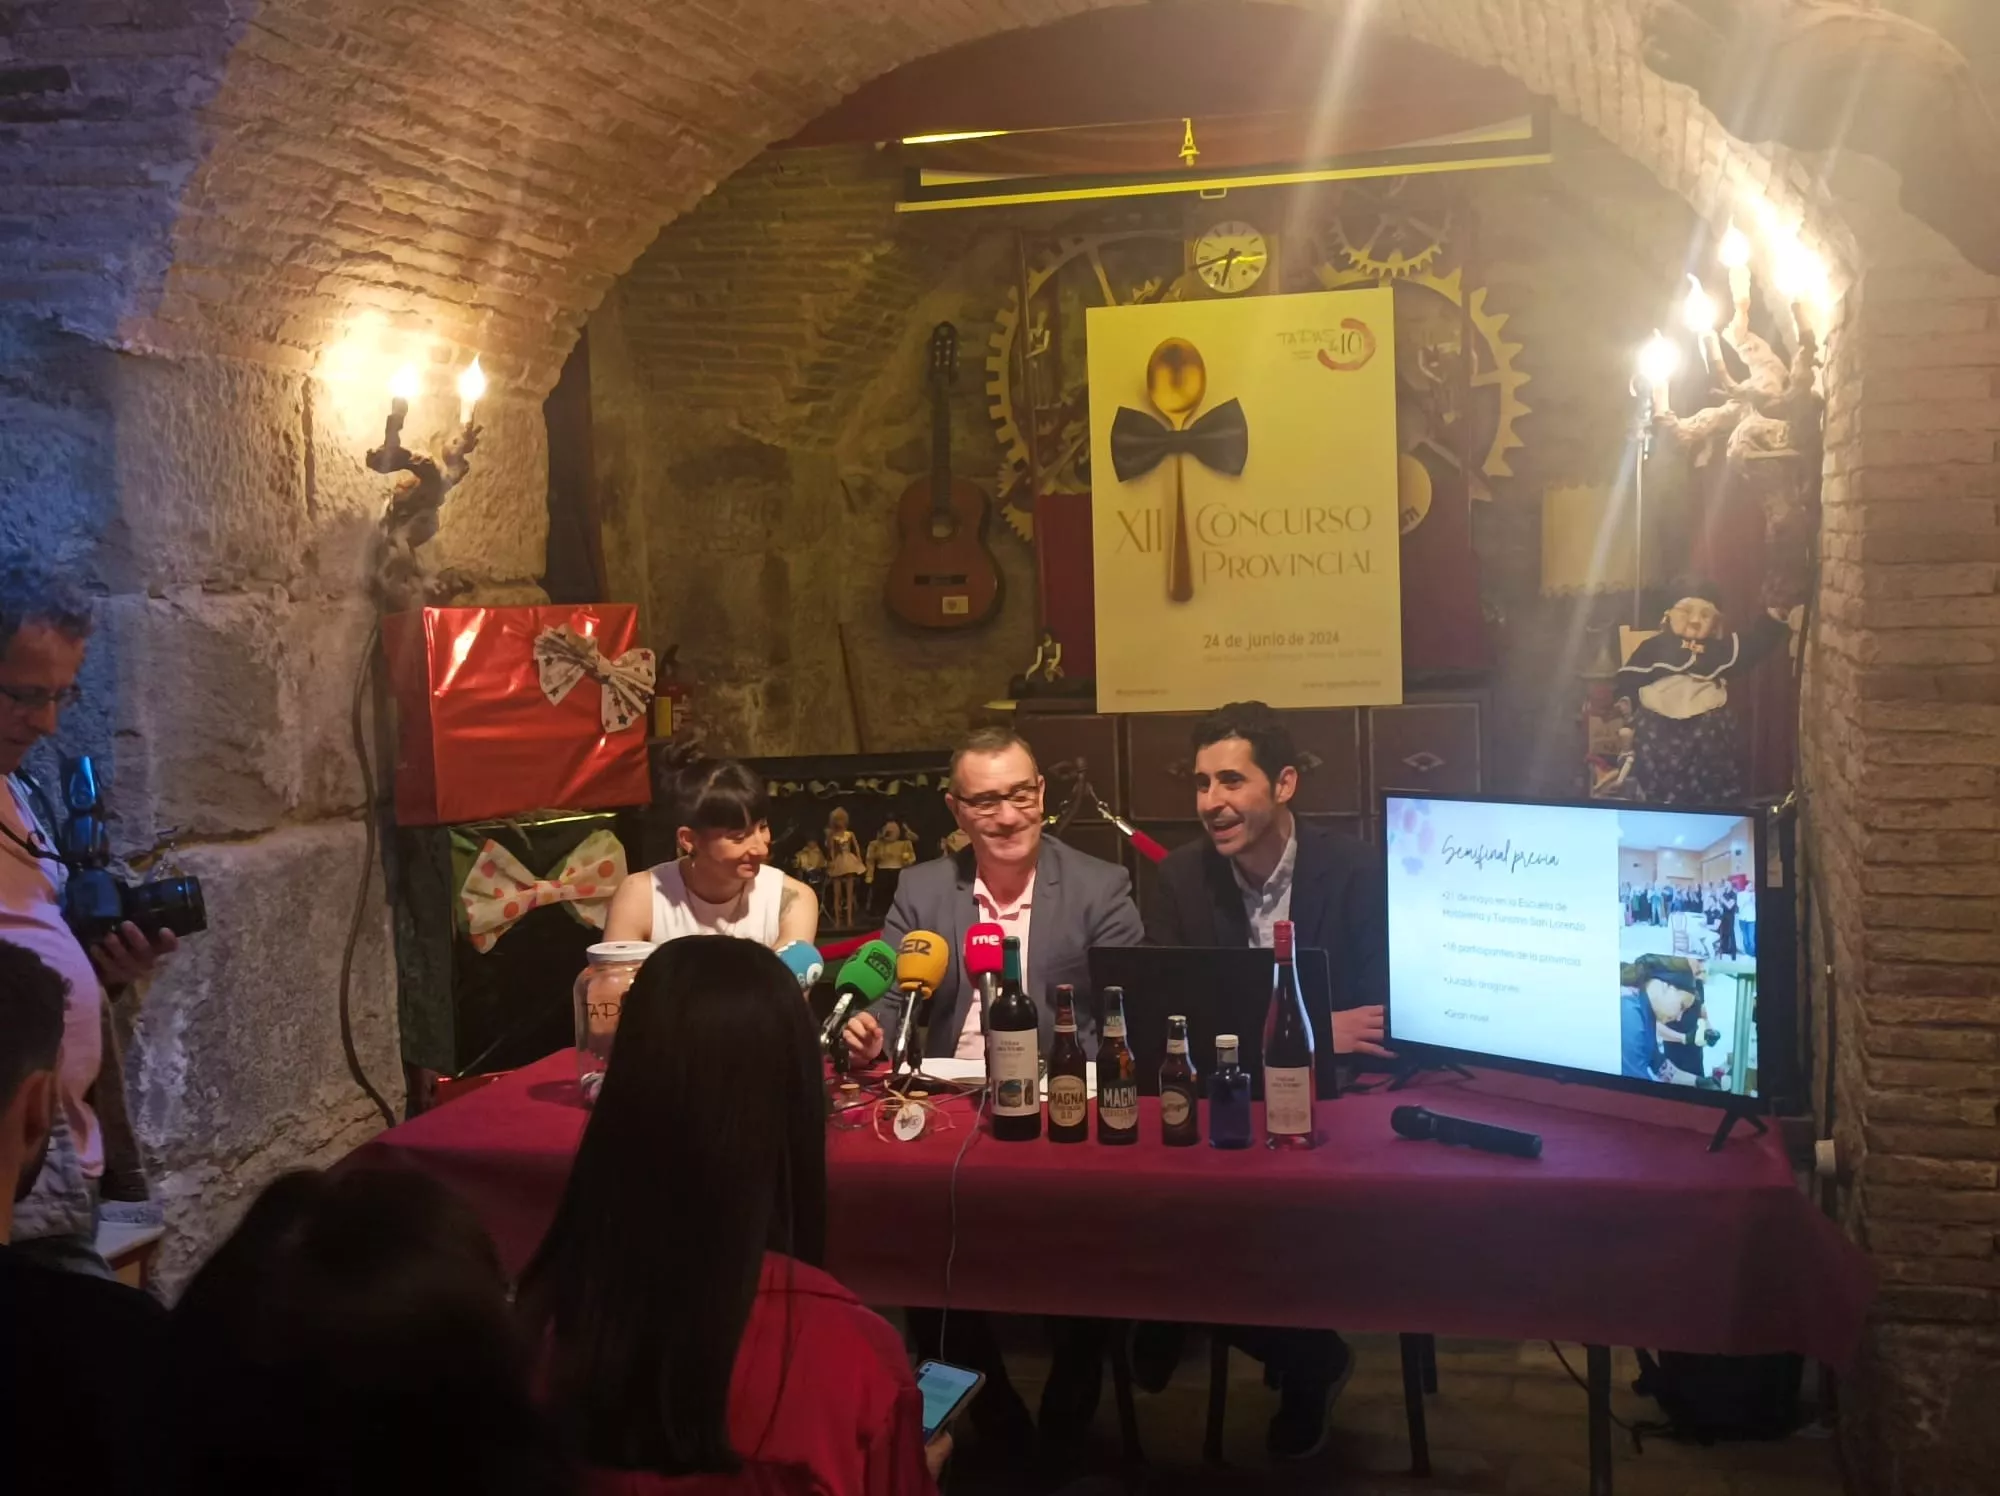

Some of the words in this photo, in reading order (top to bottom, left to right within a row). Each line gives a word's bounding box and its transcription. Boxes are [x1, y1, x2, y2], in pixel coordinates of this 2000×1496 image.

[1341, 331, 1362, 354] 10
[1116, 508, 1162, 553] XII
[1196, 503, 1372, 547] CONCURSO
[1202, 549, 1381, 585] PROVINCIAL
[1204, 634, 1220, 649] 24
[1225, 634, 1242, 648] de
[1246, 632, 1286, 651] junio
[1288, 632, 1304, 646] de
[1309, 631, 1340, 646] 2024
[1511, 850, 1560, 874] previa
[972, 934, 1000, 946] rne
[582, 1001, 621, 1020] TAP
[1049, 1091, 1084, 1106] MAGNA
